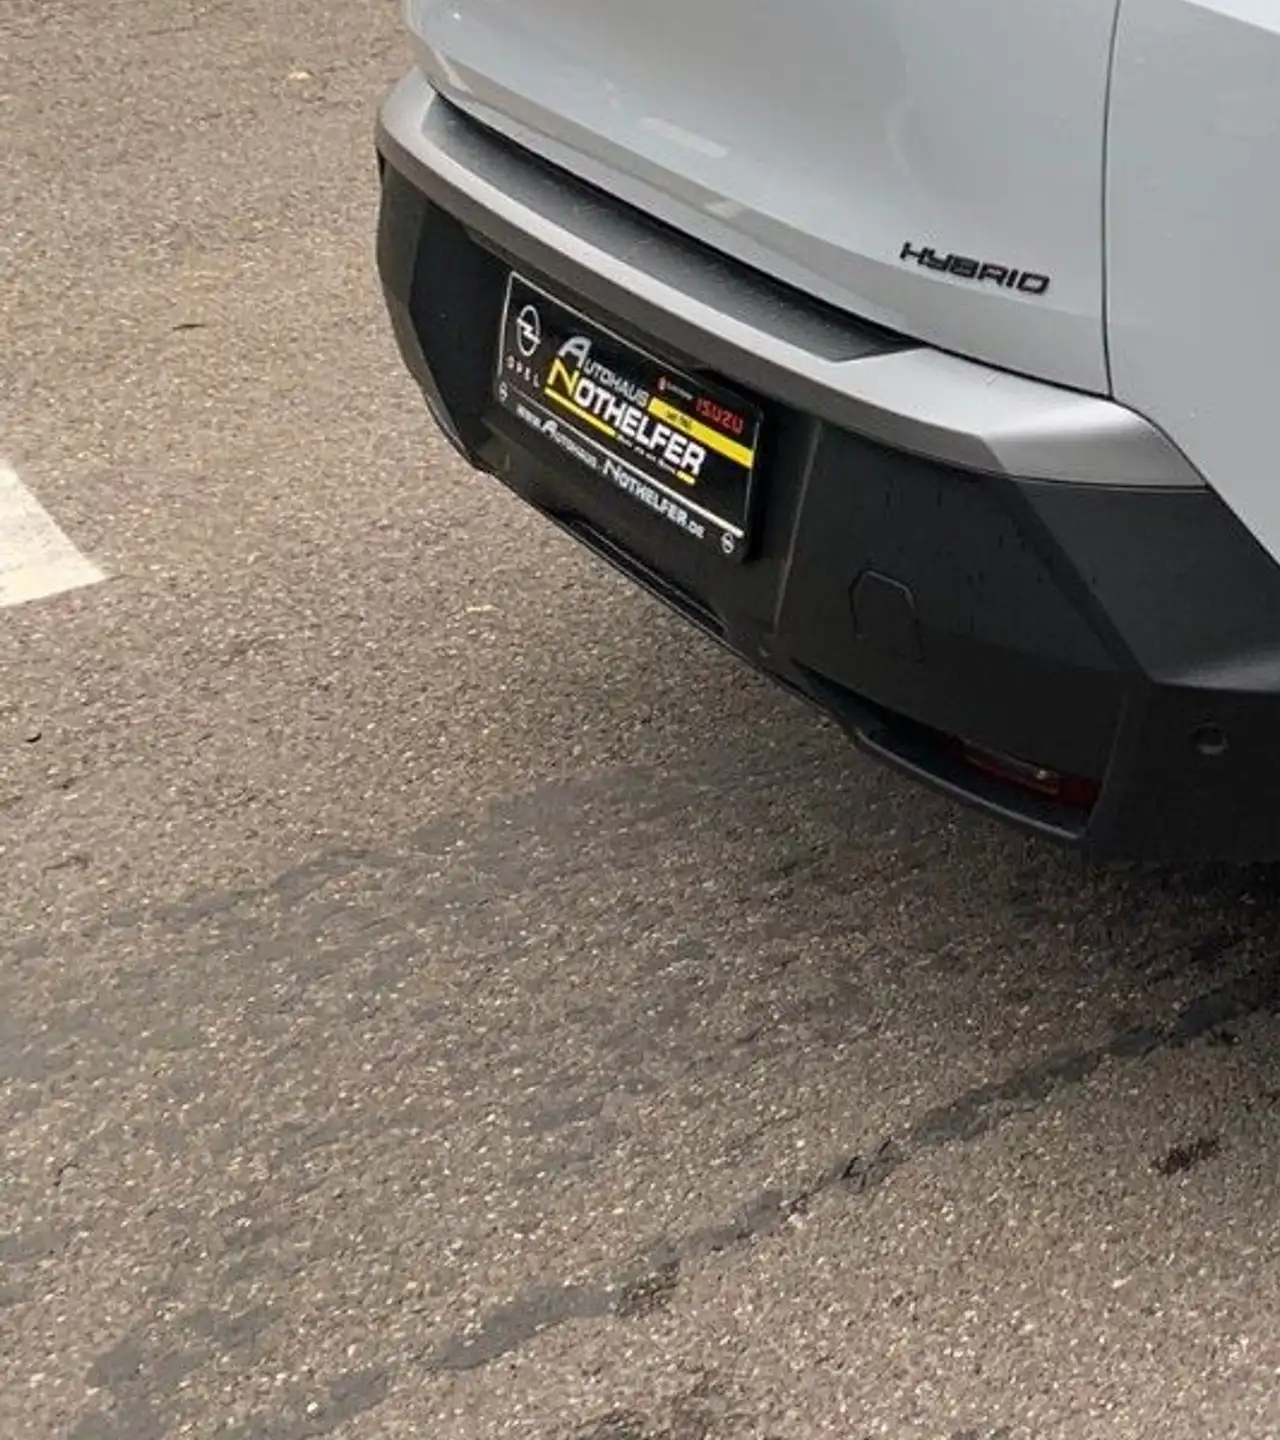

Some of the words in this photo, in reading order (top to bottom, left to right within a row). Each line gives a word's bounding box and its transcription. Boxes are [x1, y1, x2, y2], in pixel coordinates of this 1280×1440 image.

[898, 241, 1052, 295] HYBRID
[547, 358, 707, 477] NOTHELFER
[695, 396, 746, 434] ISUZU
